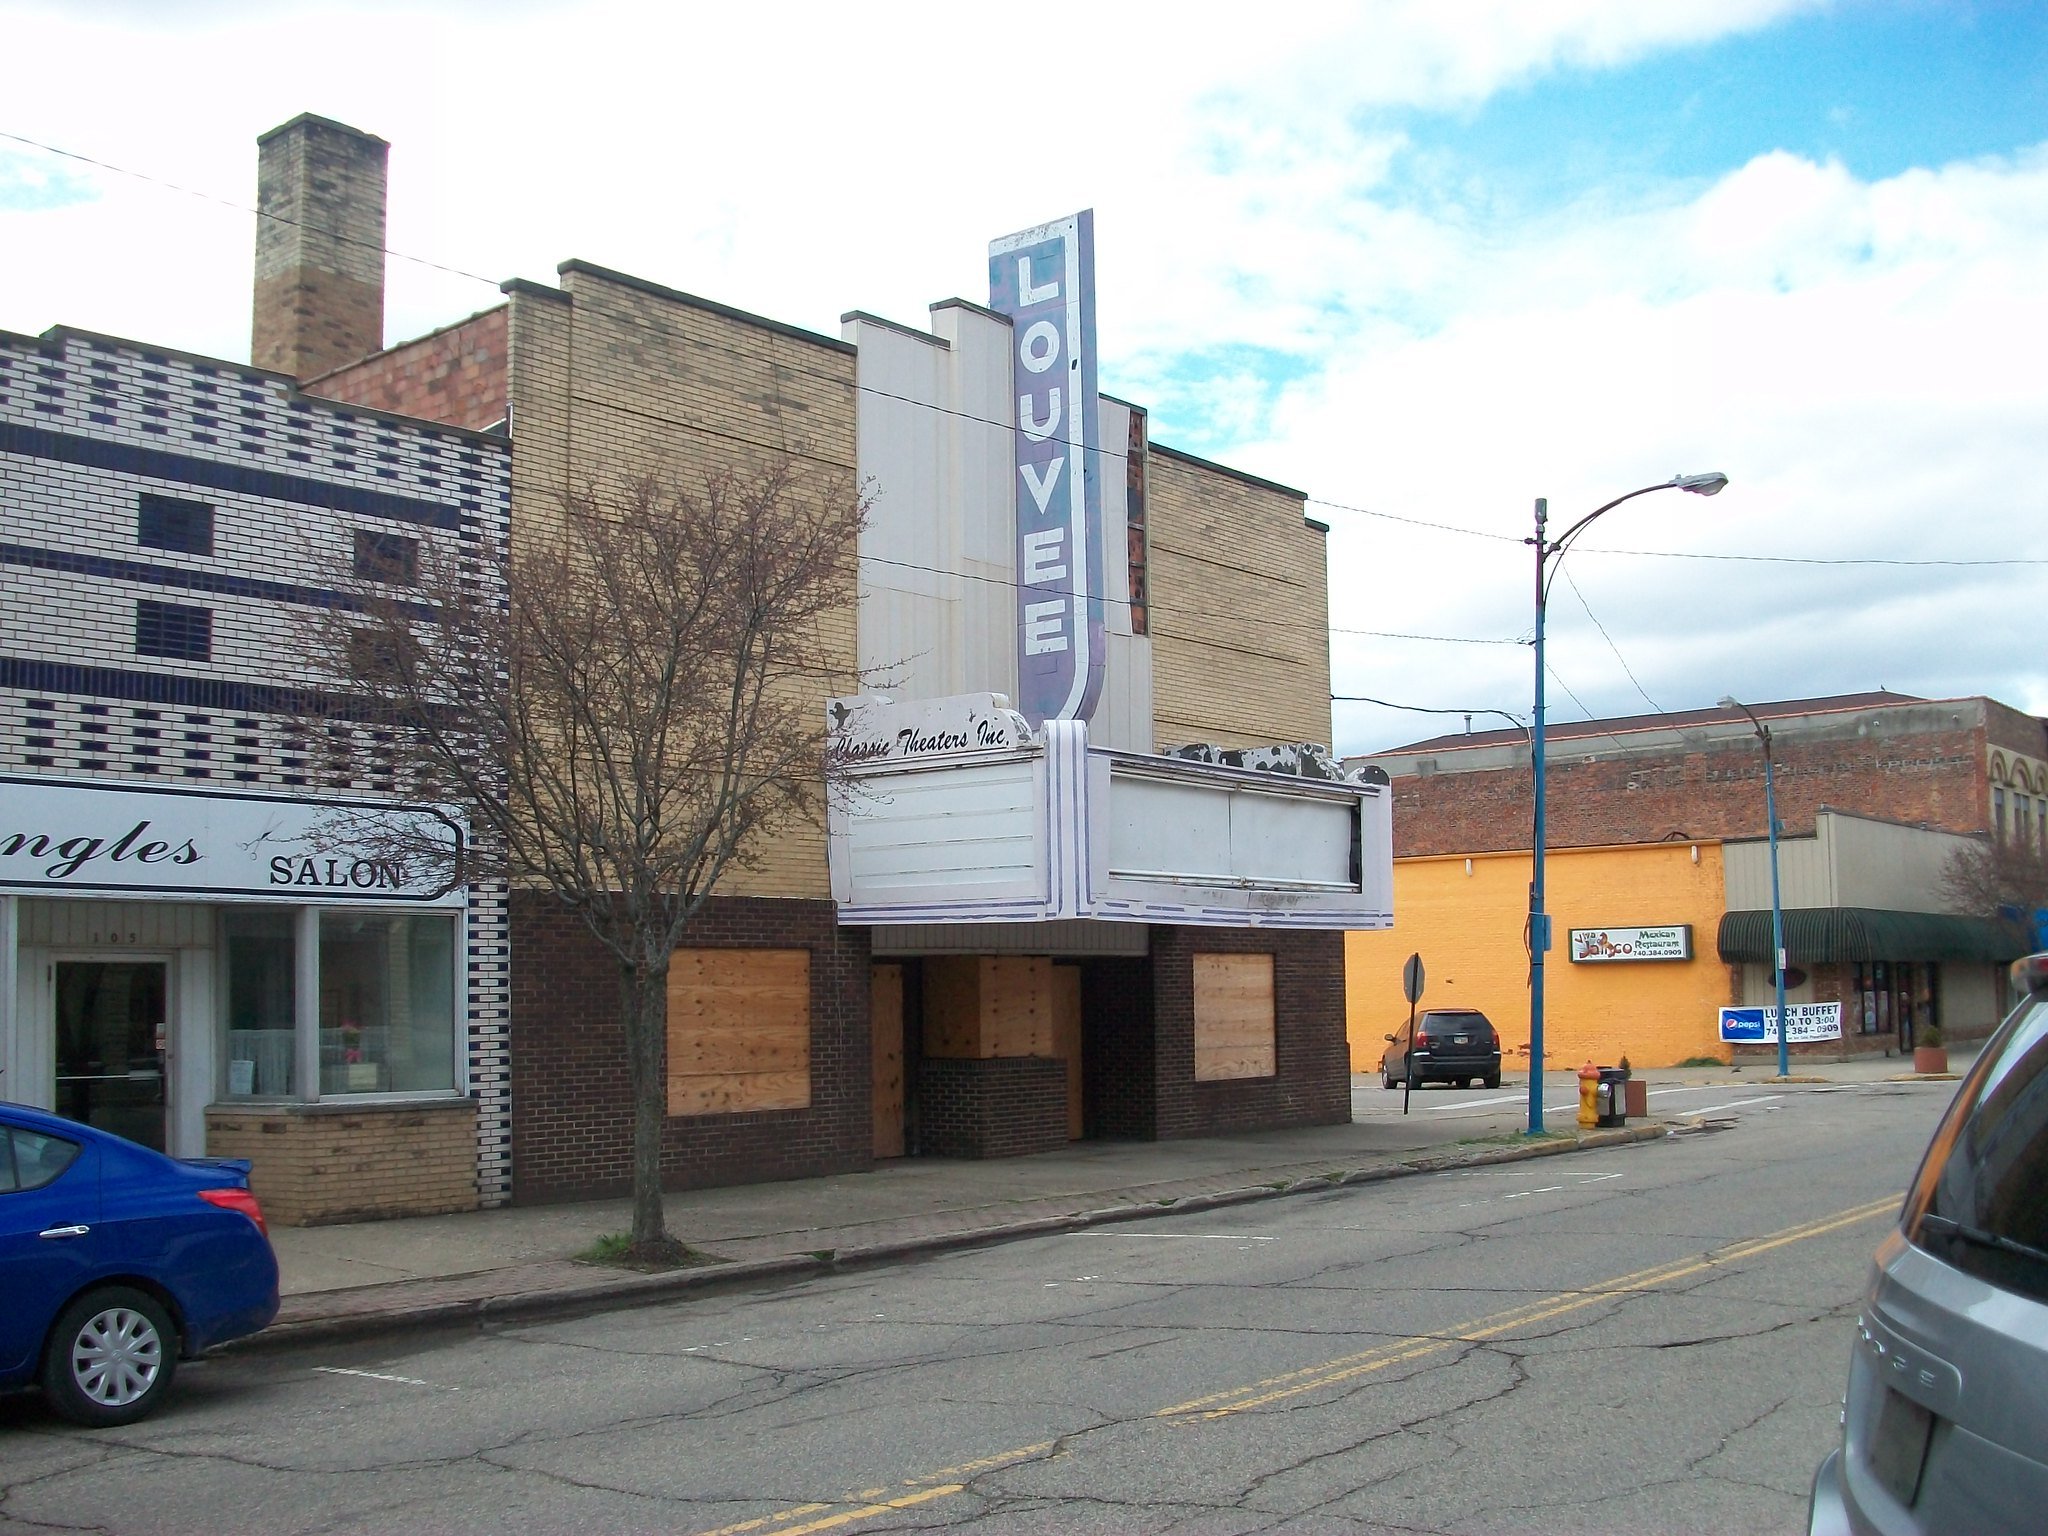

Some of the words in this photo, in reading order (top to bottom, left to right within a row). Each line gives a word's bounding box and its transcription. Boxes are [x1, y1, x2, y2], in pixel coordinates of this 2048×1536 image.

[1018, 256, 1068, 656] LOUVEE
[897, 728, 968, 756] Theaters
[976, 720, 1010, 747] Inc.
[270, 857, 402, 889] SALON
[94, 932, 136, 944] 105
[1638, 930, 1676, 940] Mexican
[1634, 940, 1679, 950] Restaurant
[1765, 1007, 1797, 1018] LUCH
[1802, 1004, 1839, 1016] BUFFET
[1737, 1021, 1761, 1029] pepsi
[1798, 1017, 1811, 1025] TO
[1815, 1015, 1835, 1025] 3:00
